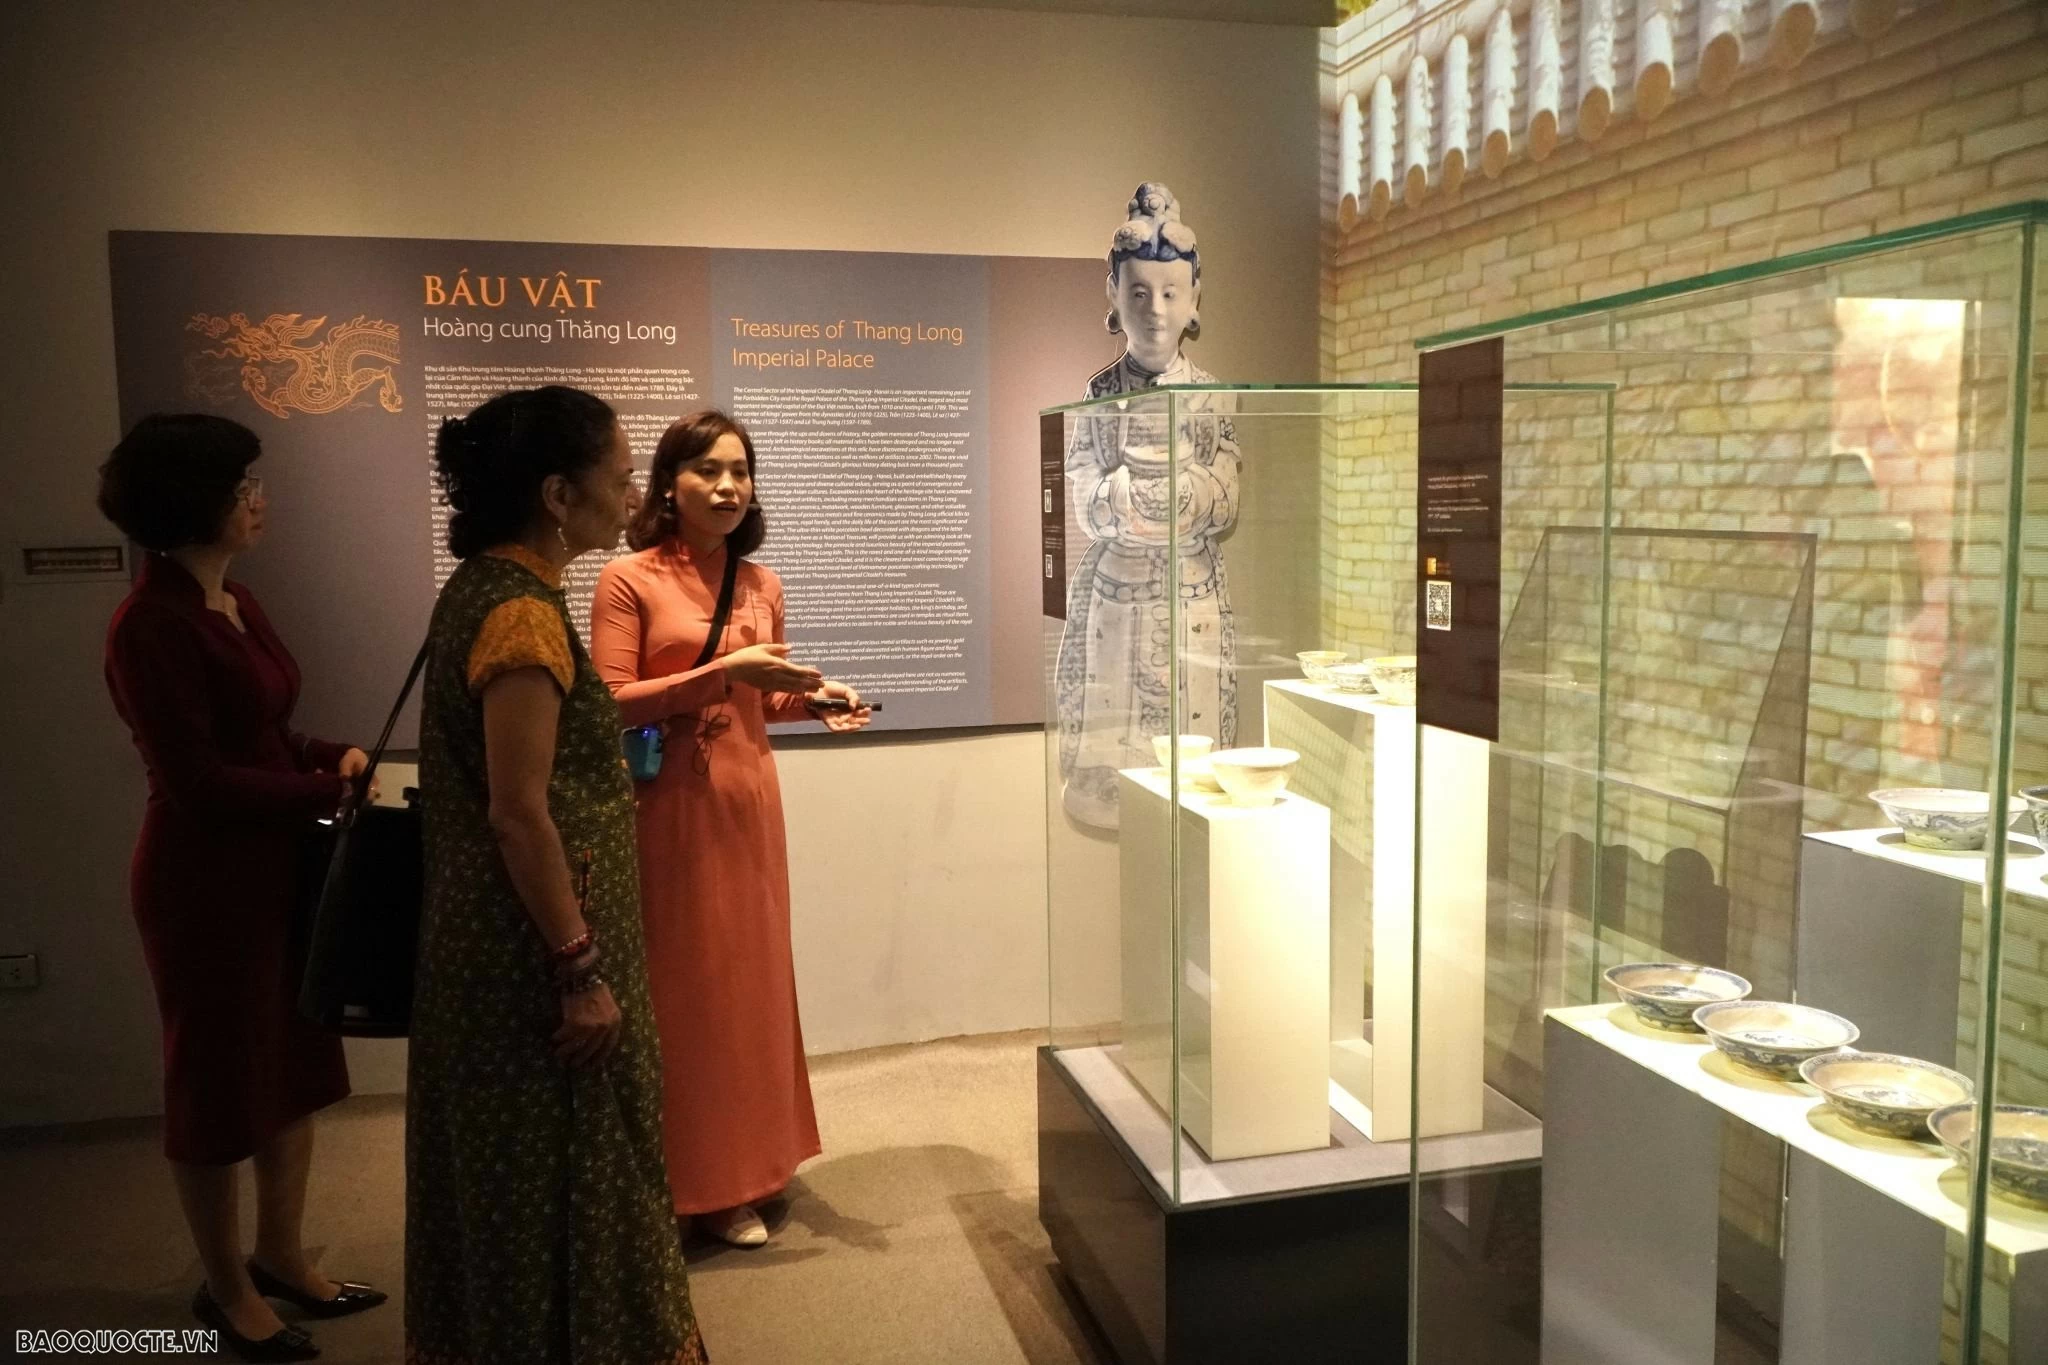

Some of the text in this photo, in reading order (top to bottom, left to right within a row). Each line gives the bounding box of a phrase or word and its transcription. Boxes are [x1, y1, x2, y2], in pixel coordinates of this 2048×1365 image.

[424, 268, 602, 314] BÁU VẬT
[424, 318, 676, 344] Hoàng cung Thăng Long
[732, 318, 962, 345] Treasures of Thang Long
[733, 348, 874, 370] Imperial Palace
